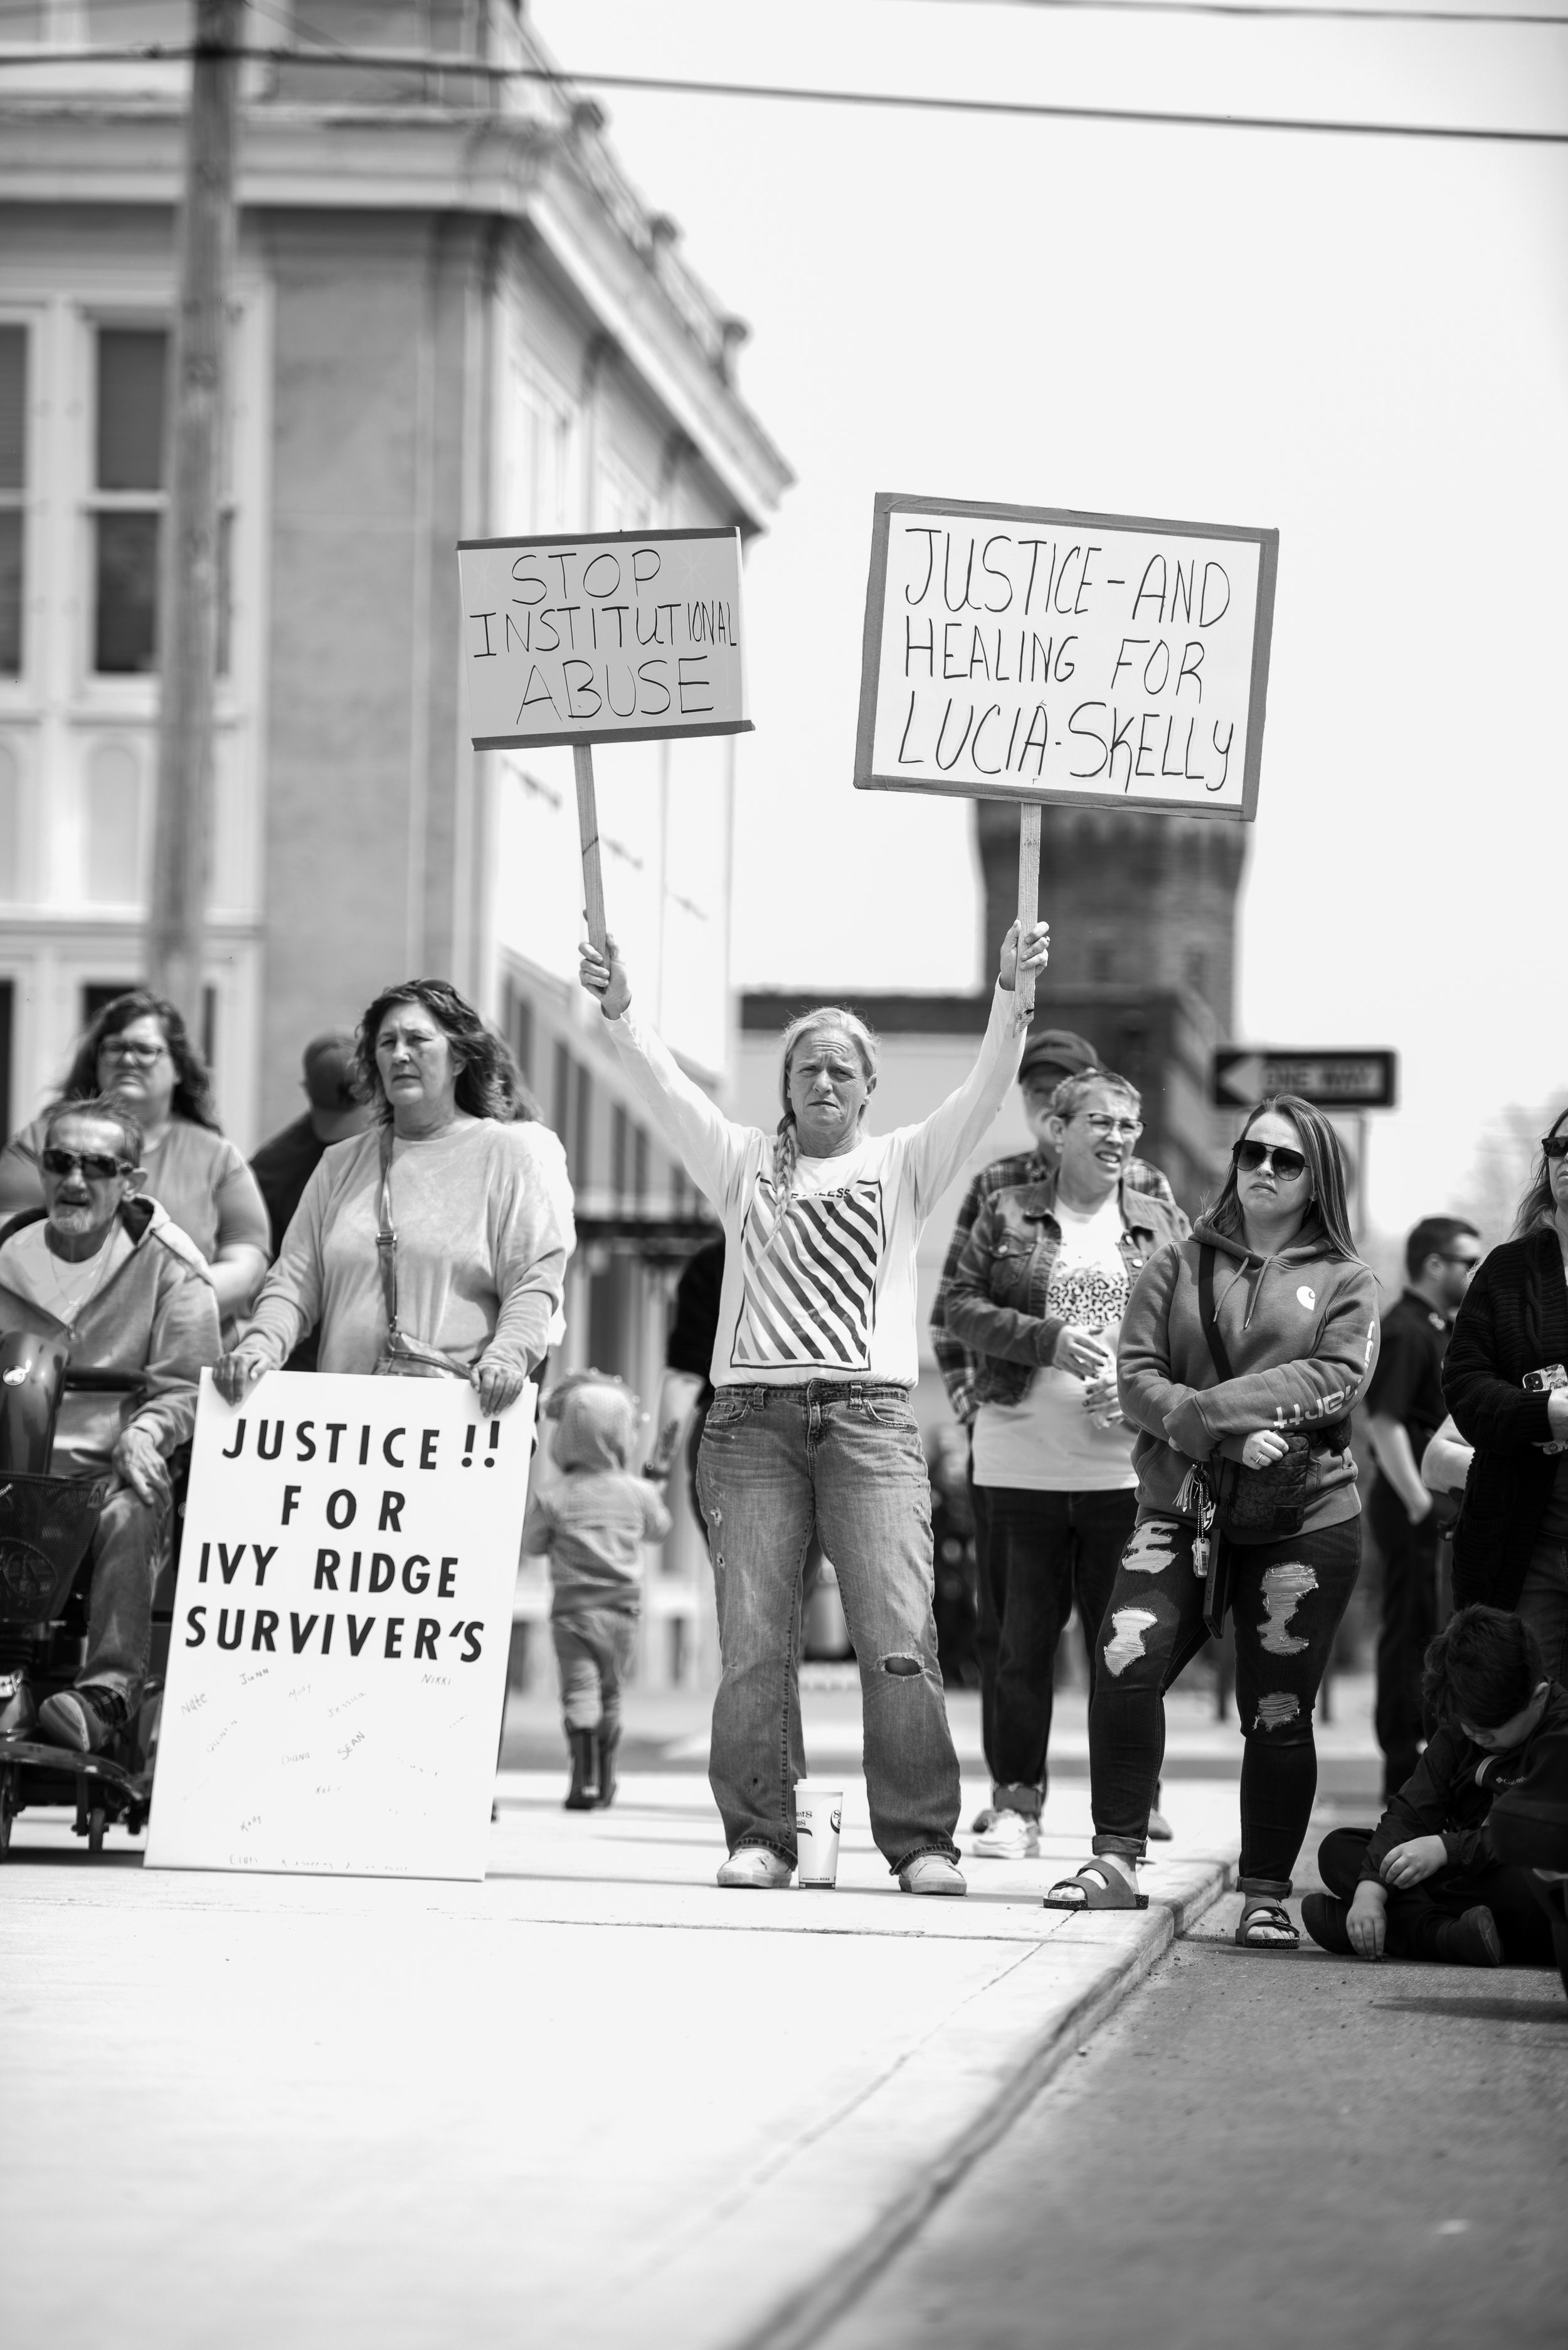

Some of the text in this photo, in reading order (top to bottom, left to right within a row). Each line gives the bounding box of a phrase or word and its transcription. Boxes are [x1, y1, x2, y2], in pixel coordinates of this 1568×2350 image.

[512, 548, 661, 605] STOP
[469, 600, 737, 658] INSTITUTIONAL
[906, 615, 1205, 704] HEALING FOR
[516, 655, 714, 726] ABUSE
[281, 1485, 405, 1532] FOR
[198, 1543, 458, 1598] IVY RIDGE
[185, 1605, 484, 1663] SURVIVER'S
